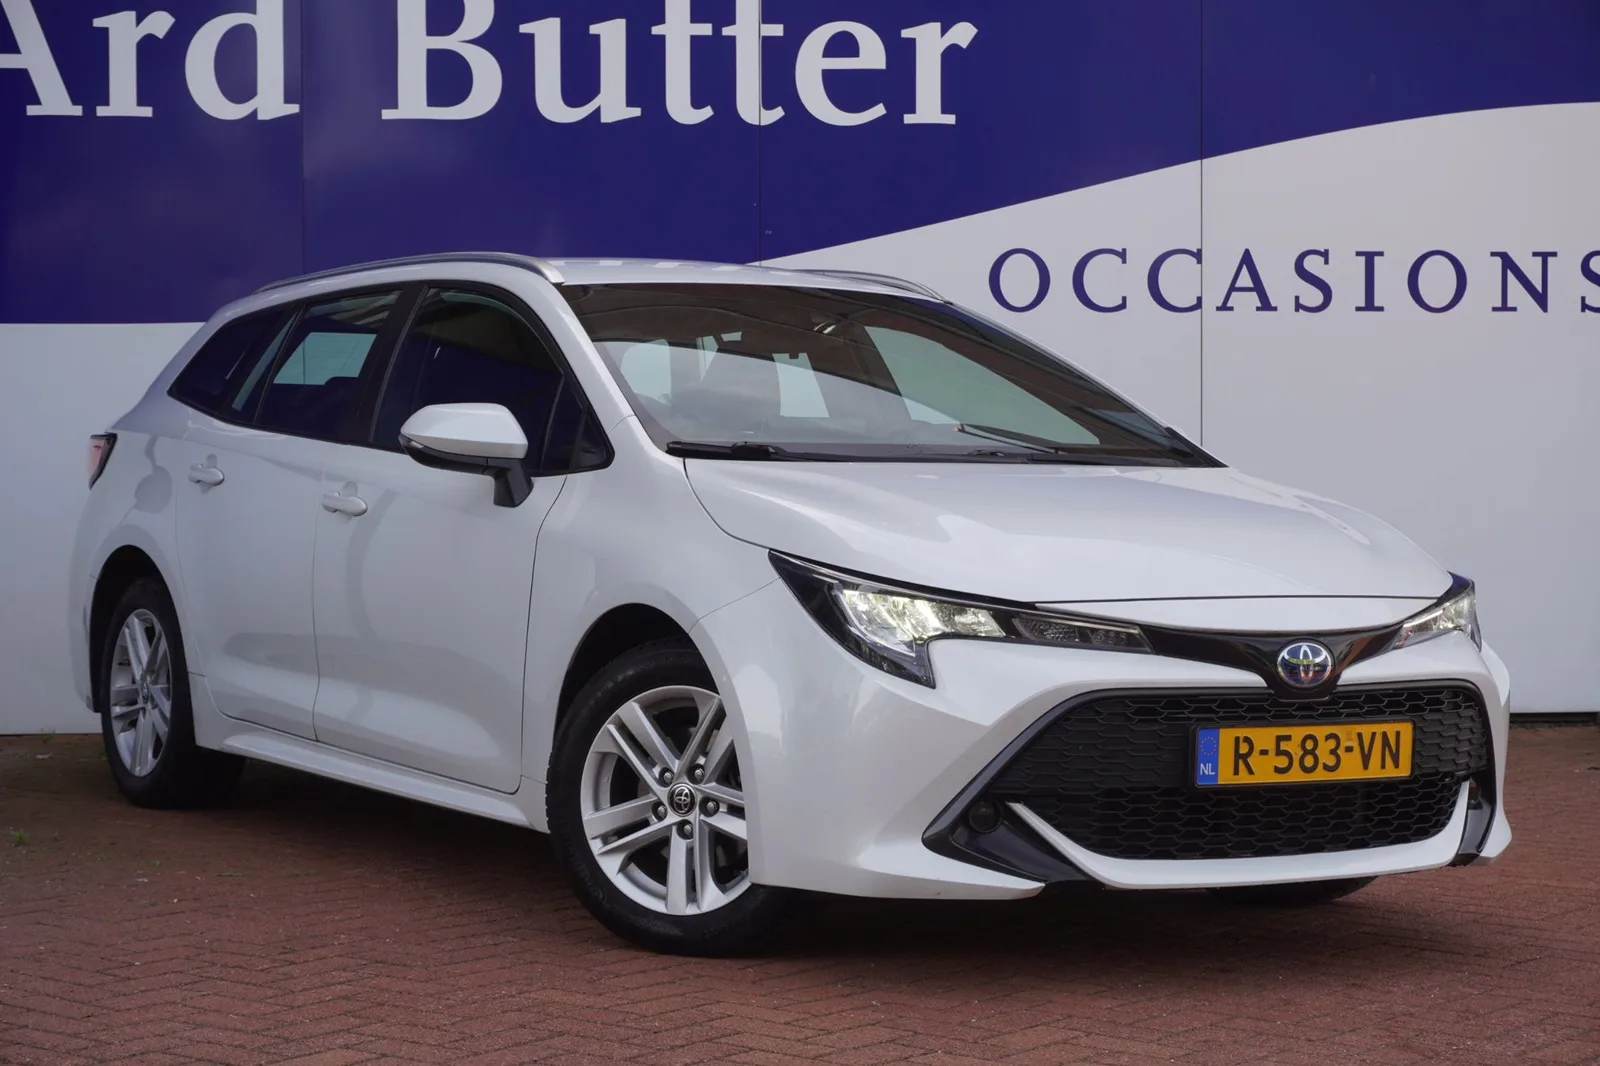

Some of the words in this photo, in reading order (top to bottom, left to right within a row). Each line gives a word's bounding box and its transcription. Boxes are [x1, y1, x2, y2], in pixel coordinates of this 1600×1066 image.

[381, 0, 978, 127] Butter
[1200, 763, 1216, 775] NL
[1233, 730, 1401, 776] R-583-VN
